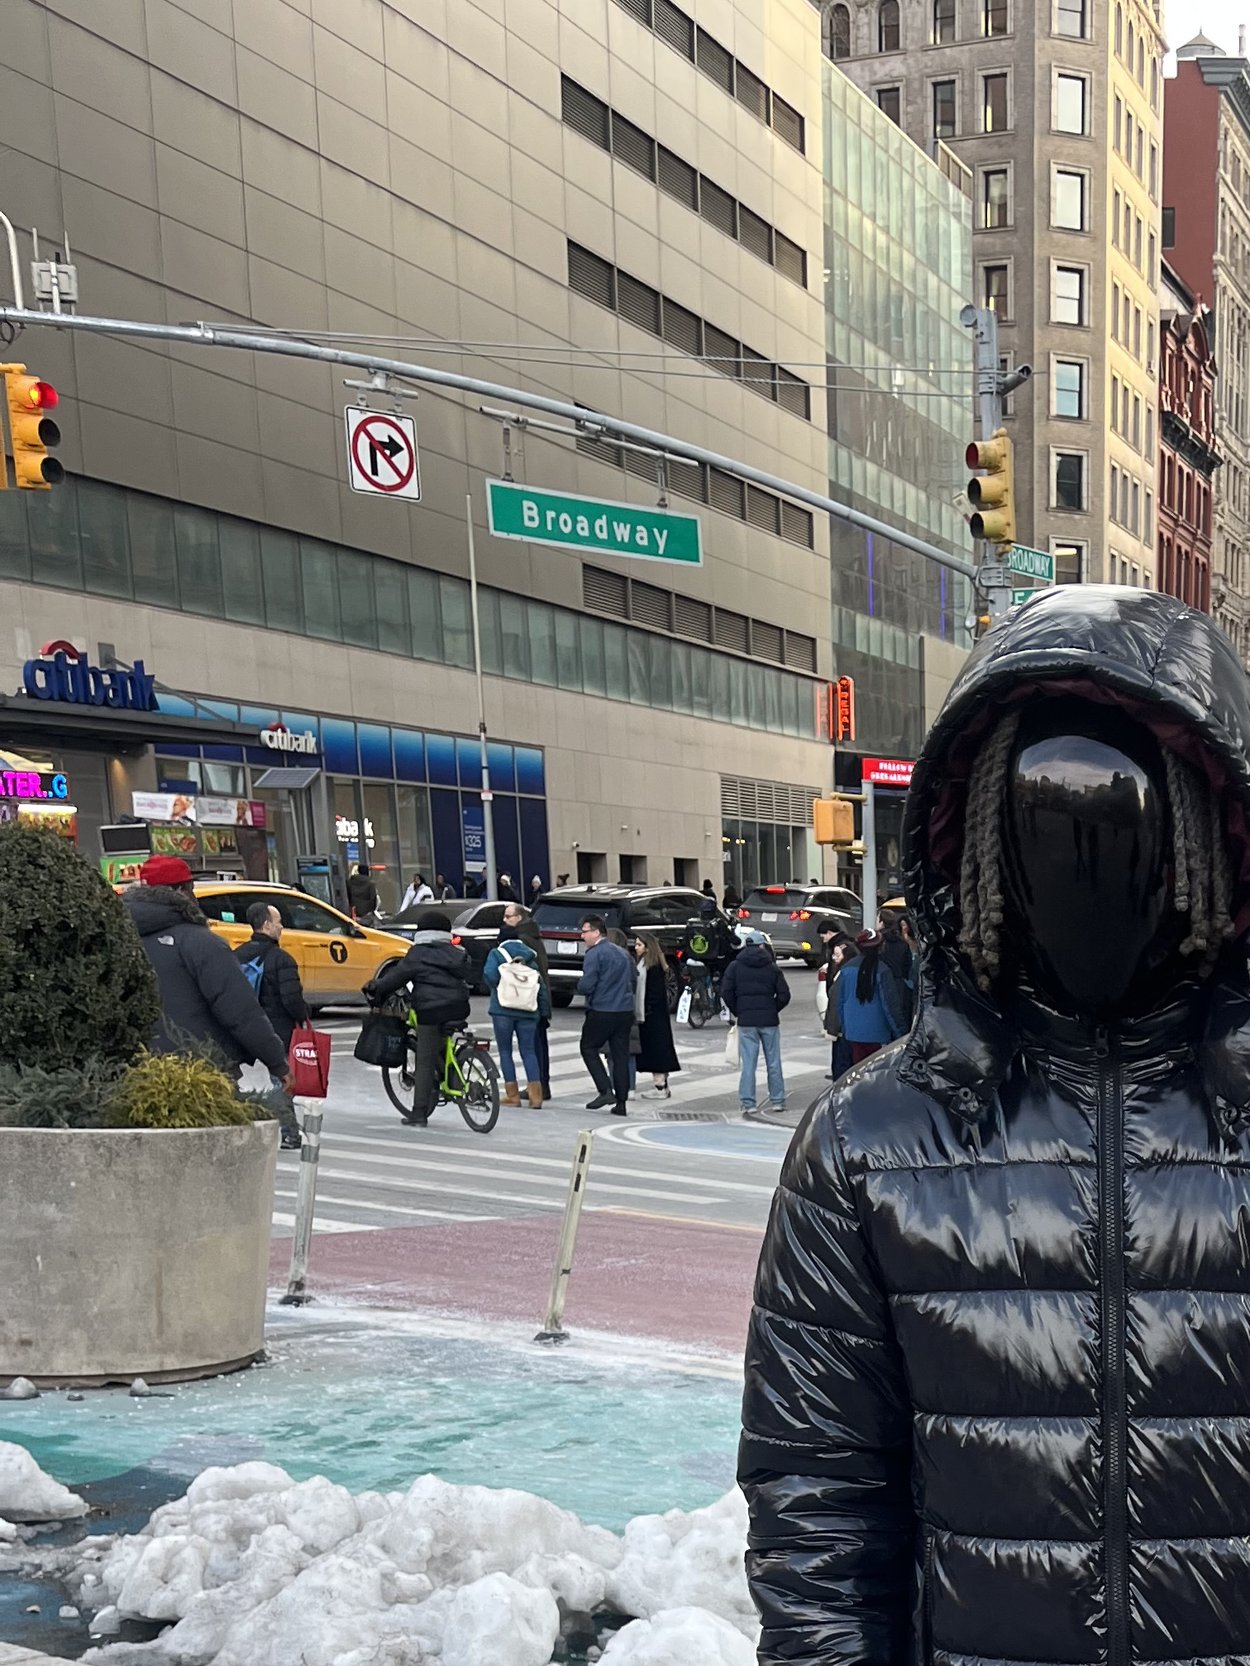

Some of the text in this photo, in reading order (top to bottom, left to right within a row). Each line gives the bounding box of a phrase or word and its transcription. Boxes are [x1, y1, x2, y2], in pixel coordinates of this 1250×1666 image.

[521, 499, 668, 555] Broadway
[23, 651, 160, 711] citibank
[261, 727, 317, 754] citibank
[332, 944, 343, 961] T
[295, 1048, 317, 1058] STRA
